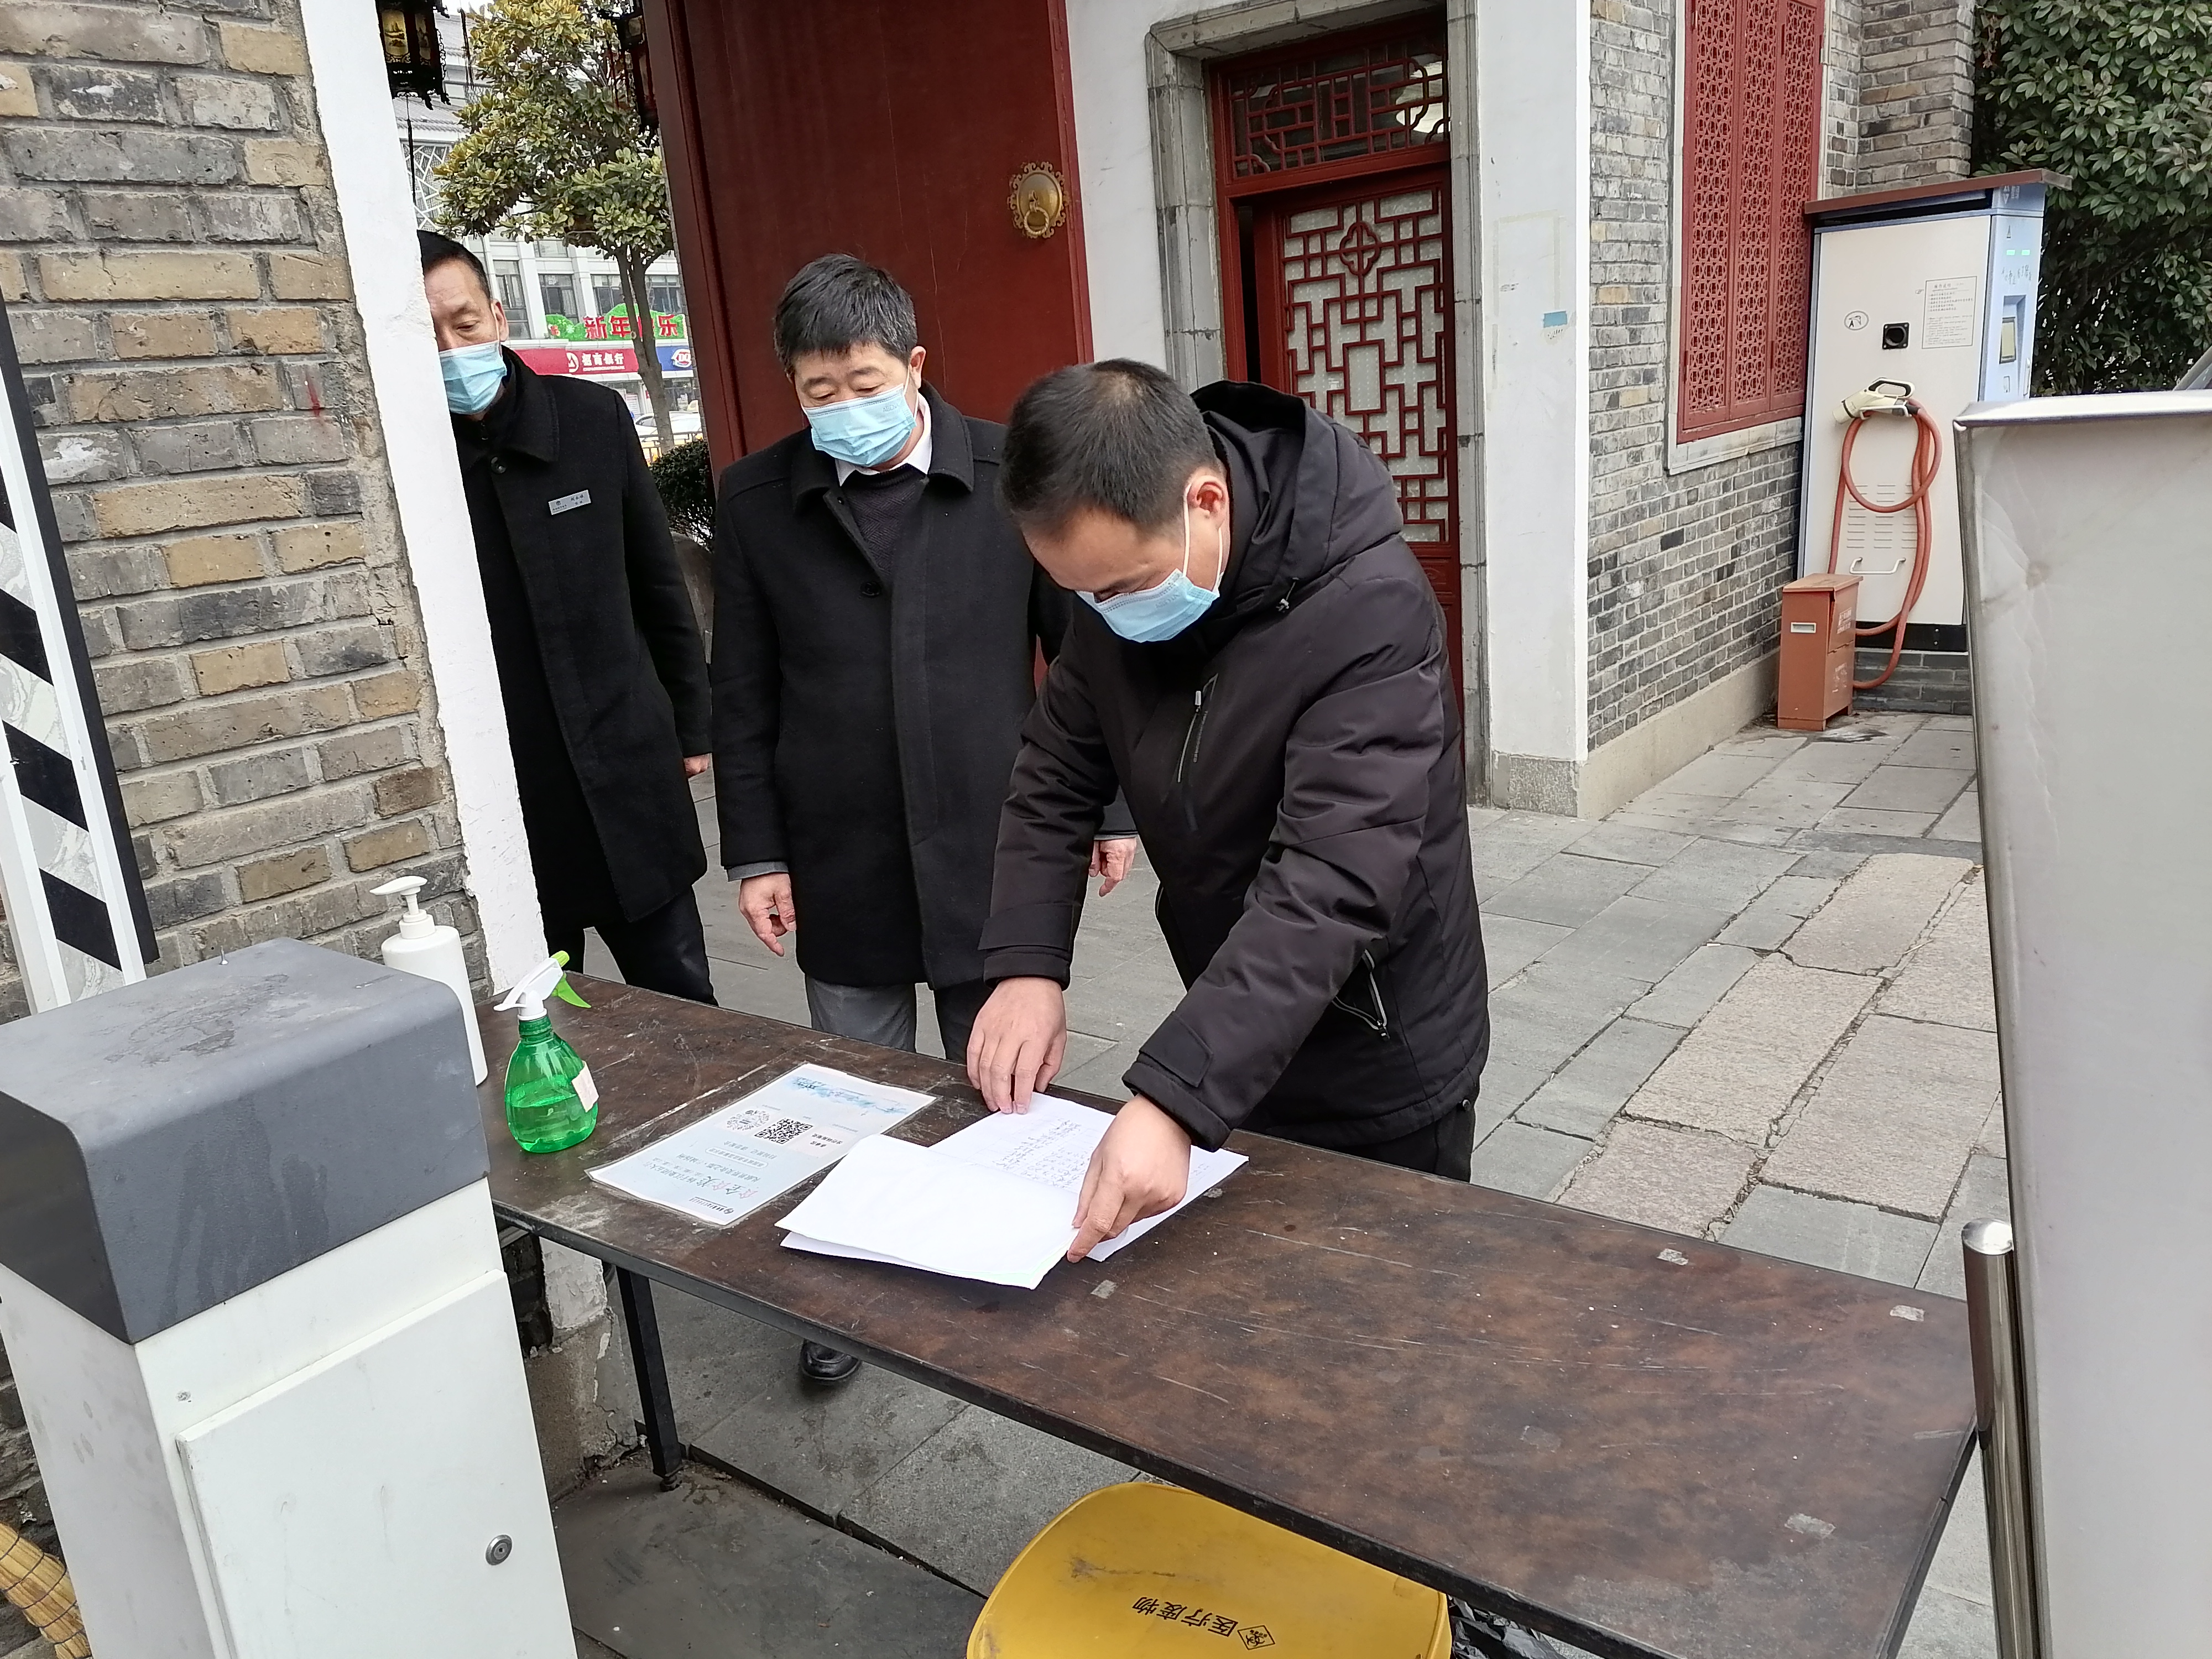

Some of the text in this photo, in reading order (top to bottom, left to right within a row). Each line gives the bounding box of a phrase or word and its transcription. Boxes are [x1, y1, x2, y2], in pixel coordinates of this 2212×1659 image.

[582, 352, 624, 366] 招商银行
[678, 354, 691, 362] DQ
[693, 1175, 759, 1200] 食全食美
[1132, 1596, 1239, 1637] 医疗废物
